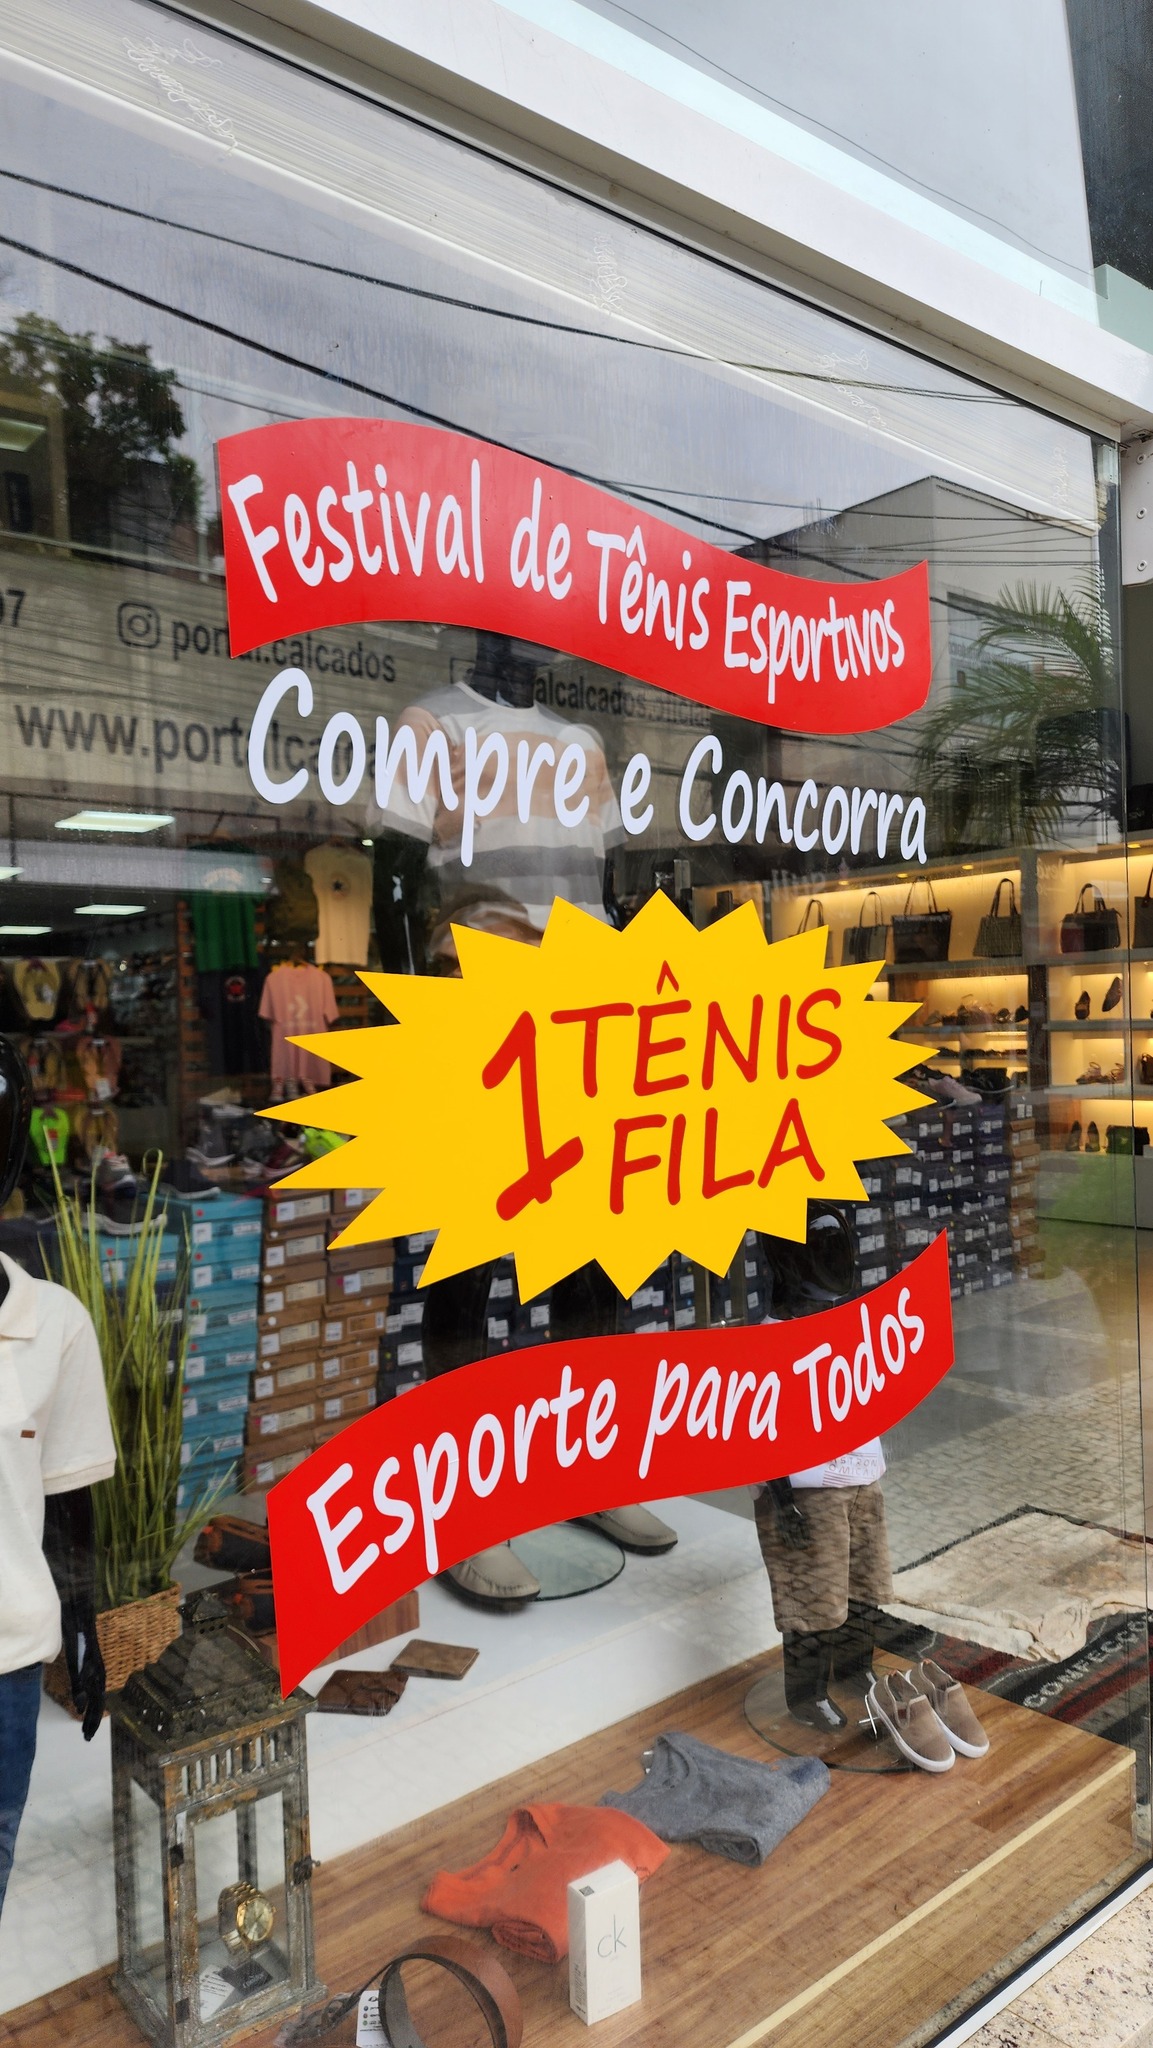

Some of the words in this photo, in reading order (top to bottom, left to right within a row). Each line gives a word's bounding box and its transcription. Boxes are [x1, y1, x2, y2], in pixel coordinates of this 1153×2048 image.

[0, 589, 26, 628] 7
[227, 459, 484, 604] Festival
[510, 477, 573, 601] de
[587, 525, 710, 651] Tênis
[723, 580, 906, 704] Esportivos
[247, 667, 591, 868] Compre
[620, 752, 655, 836] e
[680, 735, 928, 865] Concorra
[481, 1010, 585, 1222] 1
[550, 960, 844, 1099] TÊNIS
[609, 1097, 827, 1215] FILA
[306, 1365, 619, 1594] Esporte
[638, 1359, 782, 1479] para
[793, 1287, 926, 1433] Todos
[597, 1913, 628, 1958] ck
